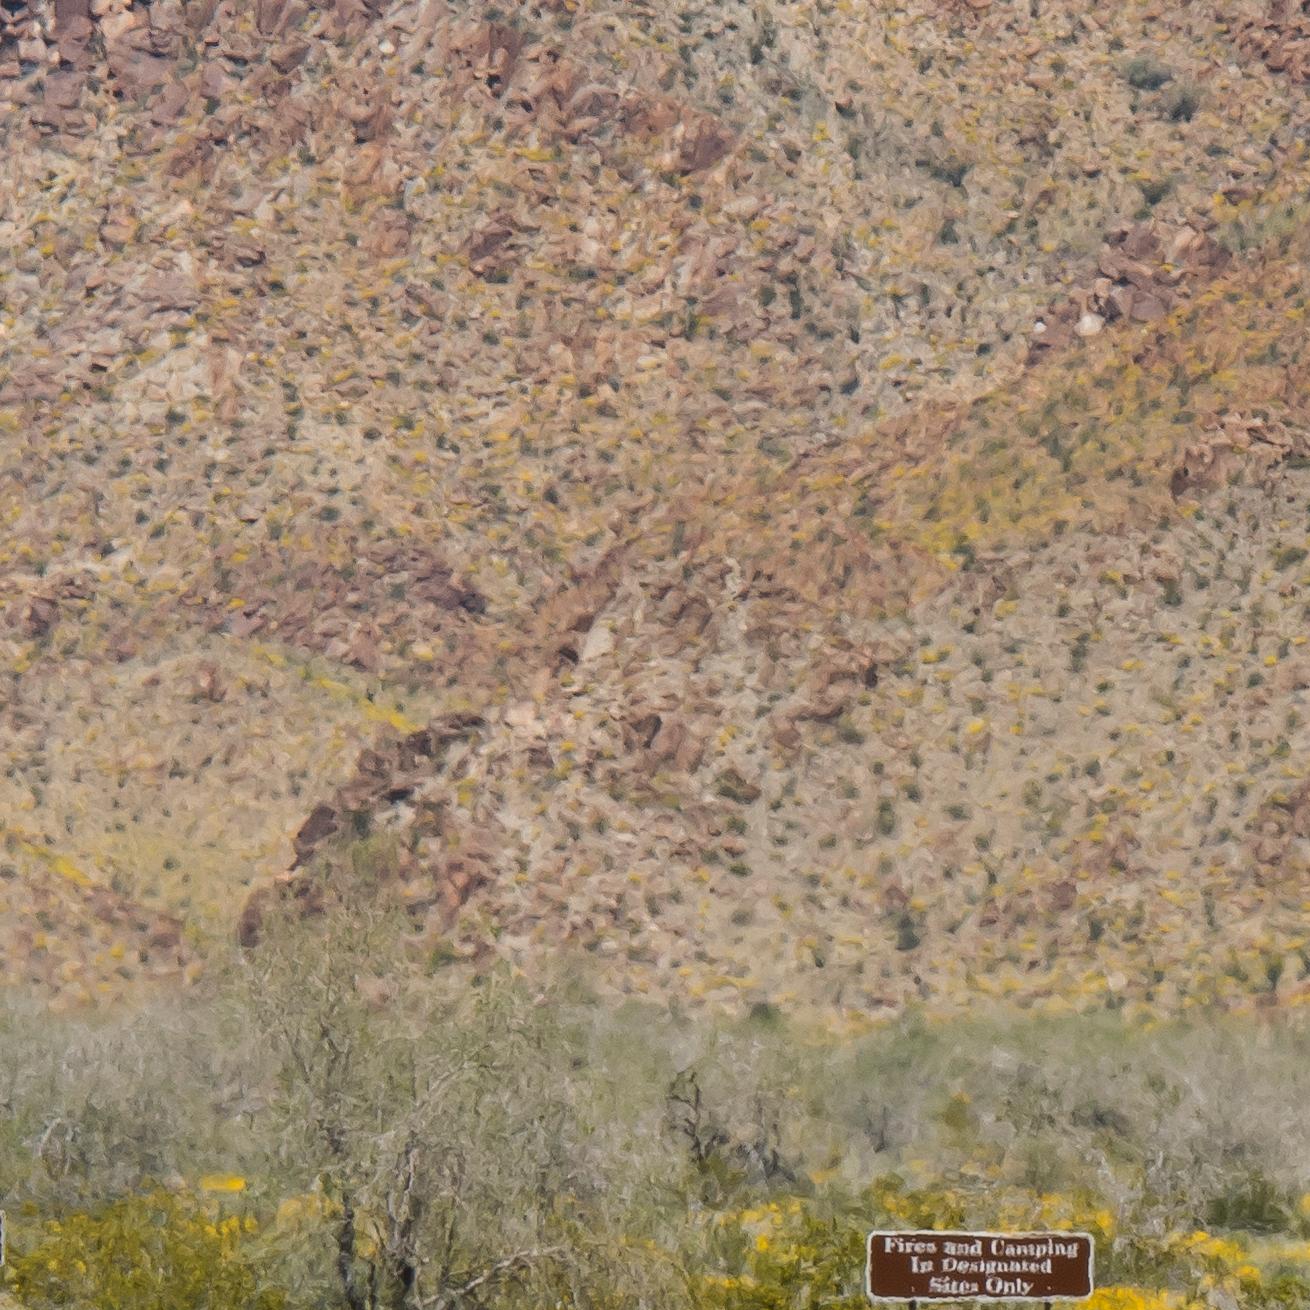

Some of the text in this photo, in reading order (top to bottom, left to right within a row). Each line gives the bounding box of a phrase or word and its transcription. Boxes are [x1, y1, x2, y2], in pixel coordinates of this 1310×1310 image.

[884, 1236, 1079, 1259] Fires and Camping
[910, 1255, 1053, 1276] In Designated
[929, 1277, 1034, 1296] Sites Only
